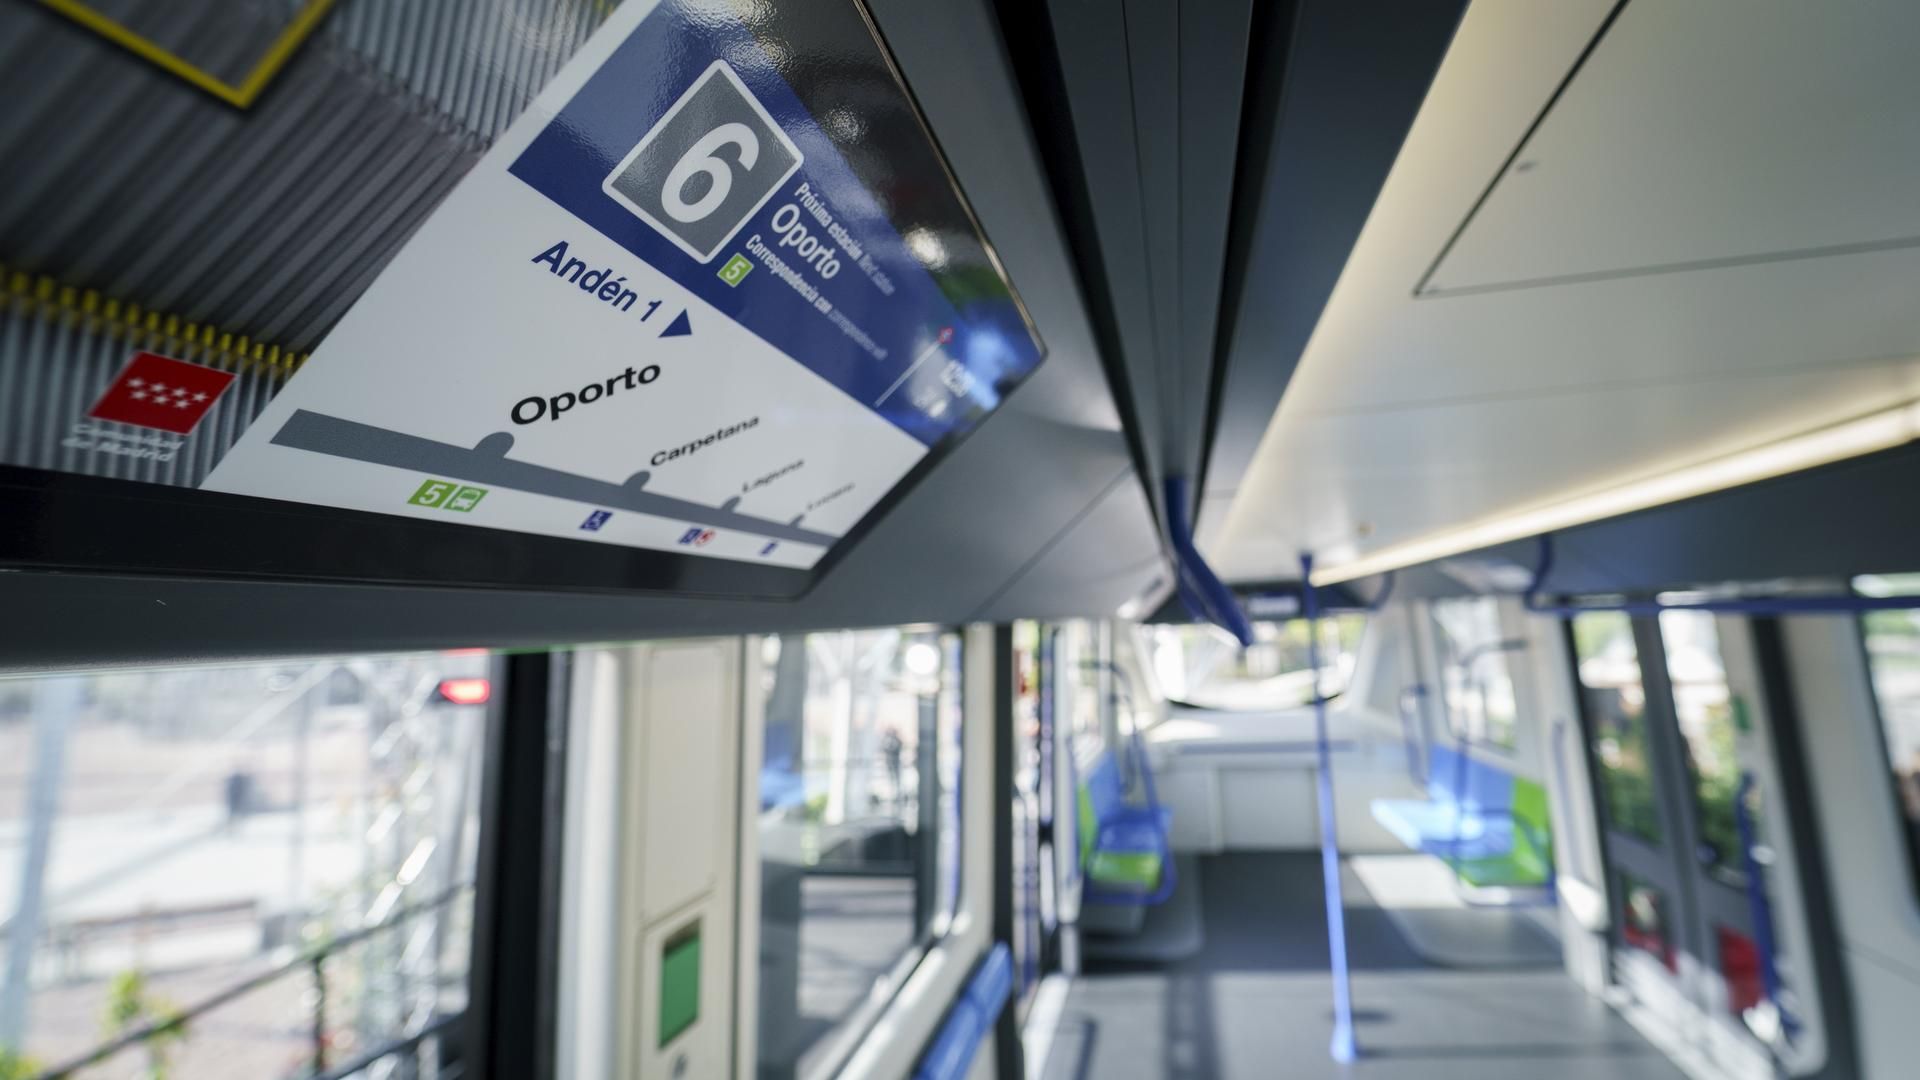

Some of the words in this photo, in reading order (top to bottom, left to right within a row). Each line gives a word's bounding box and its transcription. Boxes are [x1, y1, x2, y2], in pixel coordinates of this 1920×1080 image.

[661, 122, 759, 223] 6
[794, 182, 832, 228] Próxima
[726, 260, 746, 280] 5
[745, 234, 819, 303] Correspondencia
[771, 203, 840, 279] Oporto
[531, 240, 638, 312] Andén
[640, 300, 663, 323] 1
[510, 364, 661, 425] Oporto
[650, 416, 760, 467] Carpetana
[419, 483, 448, 505] 5
